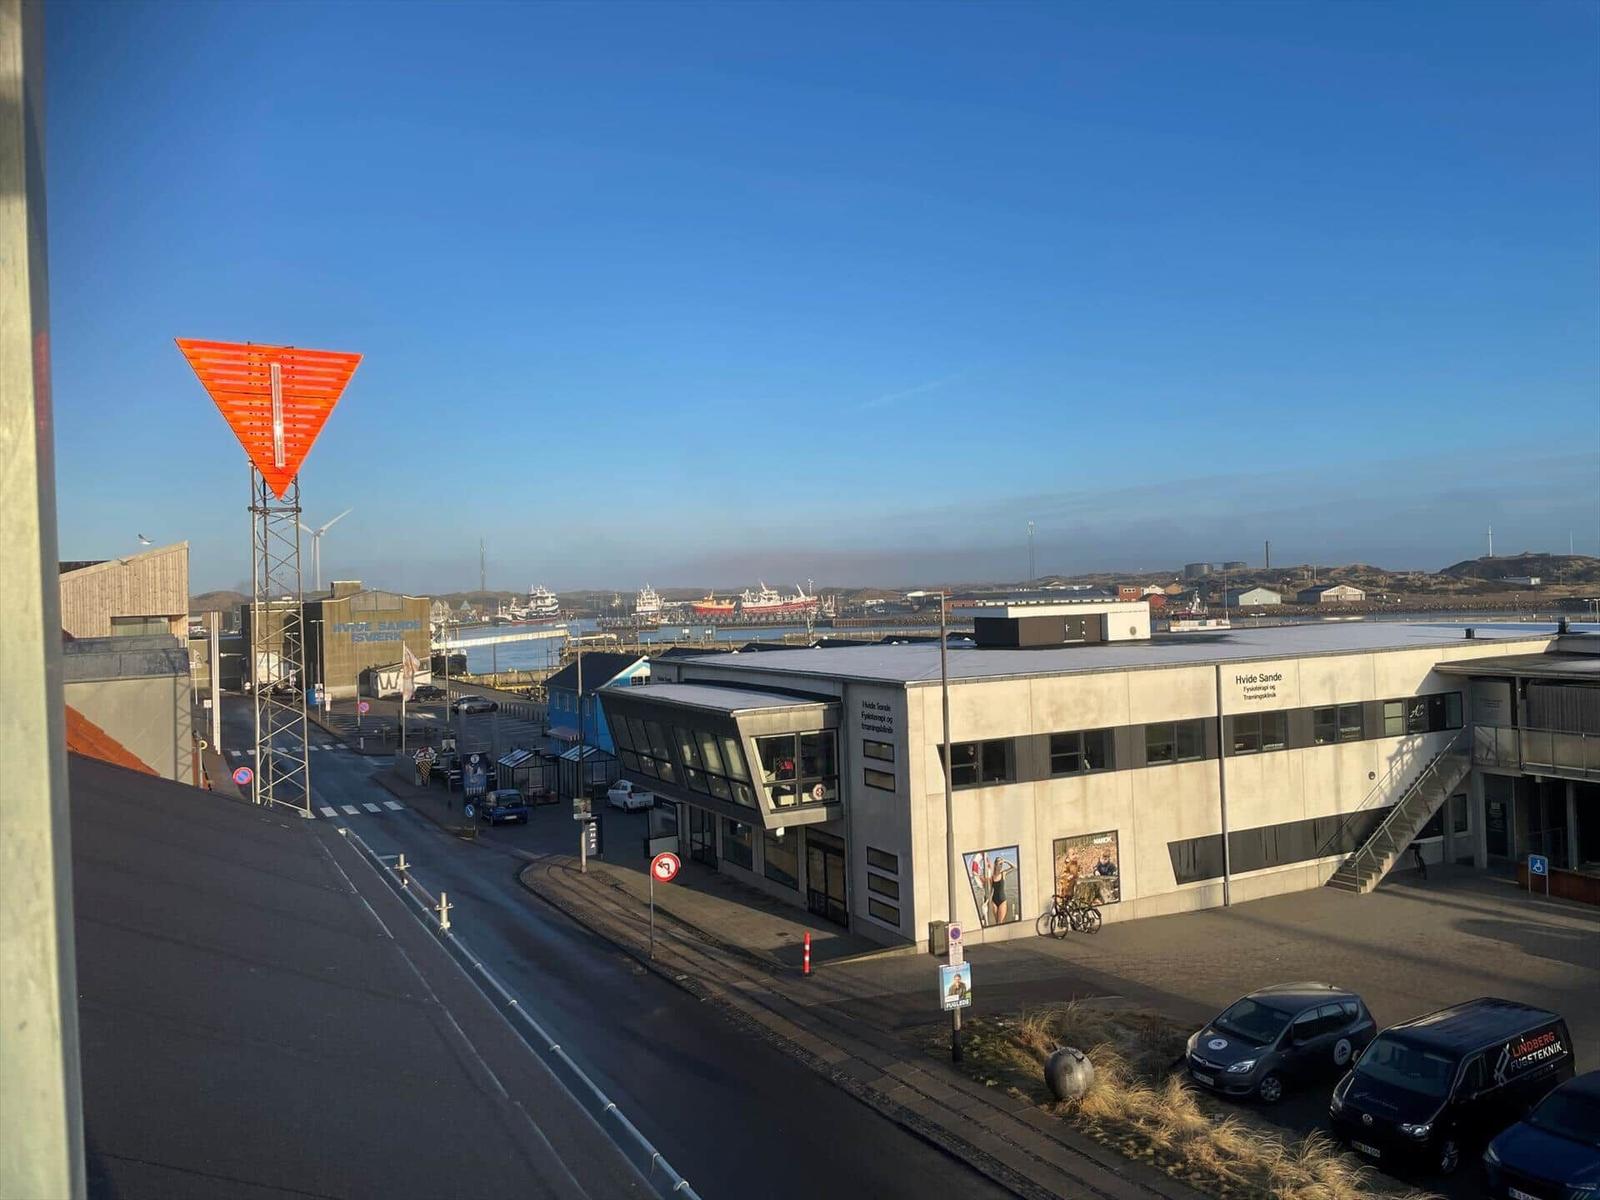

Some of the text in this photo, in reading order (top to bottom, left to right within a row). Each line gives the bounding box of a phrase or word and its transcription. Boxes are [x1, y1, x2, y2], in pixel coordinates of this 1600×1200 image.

[1235, 672, 1282, 685] Hvide Sande
[1512, 1031, 1555, 1057] LINDBERG
